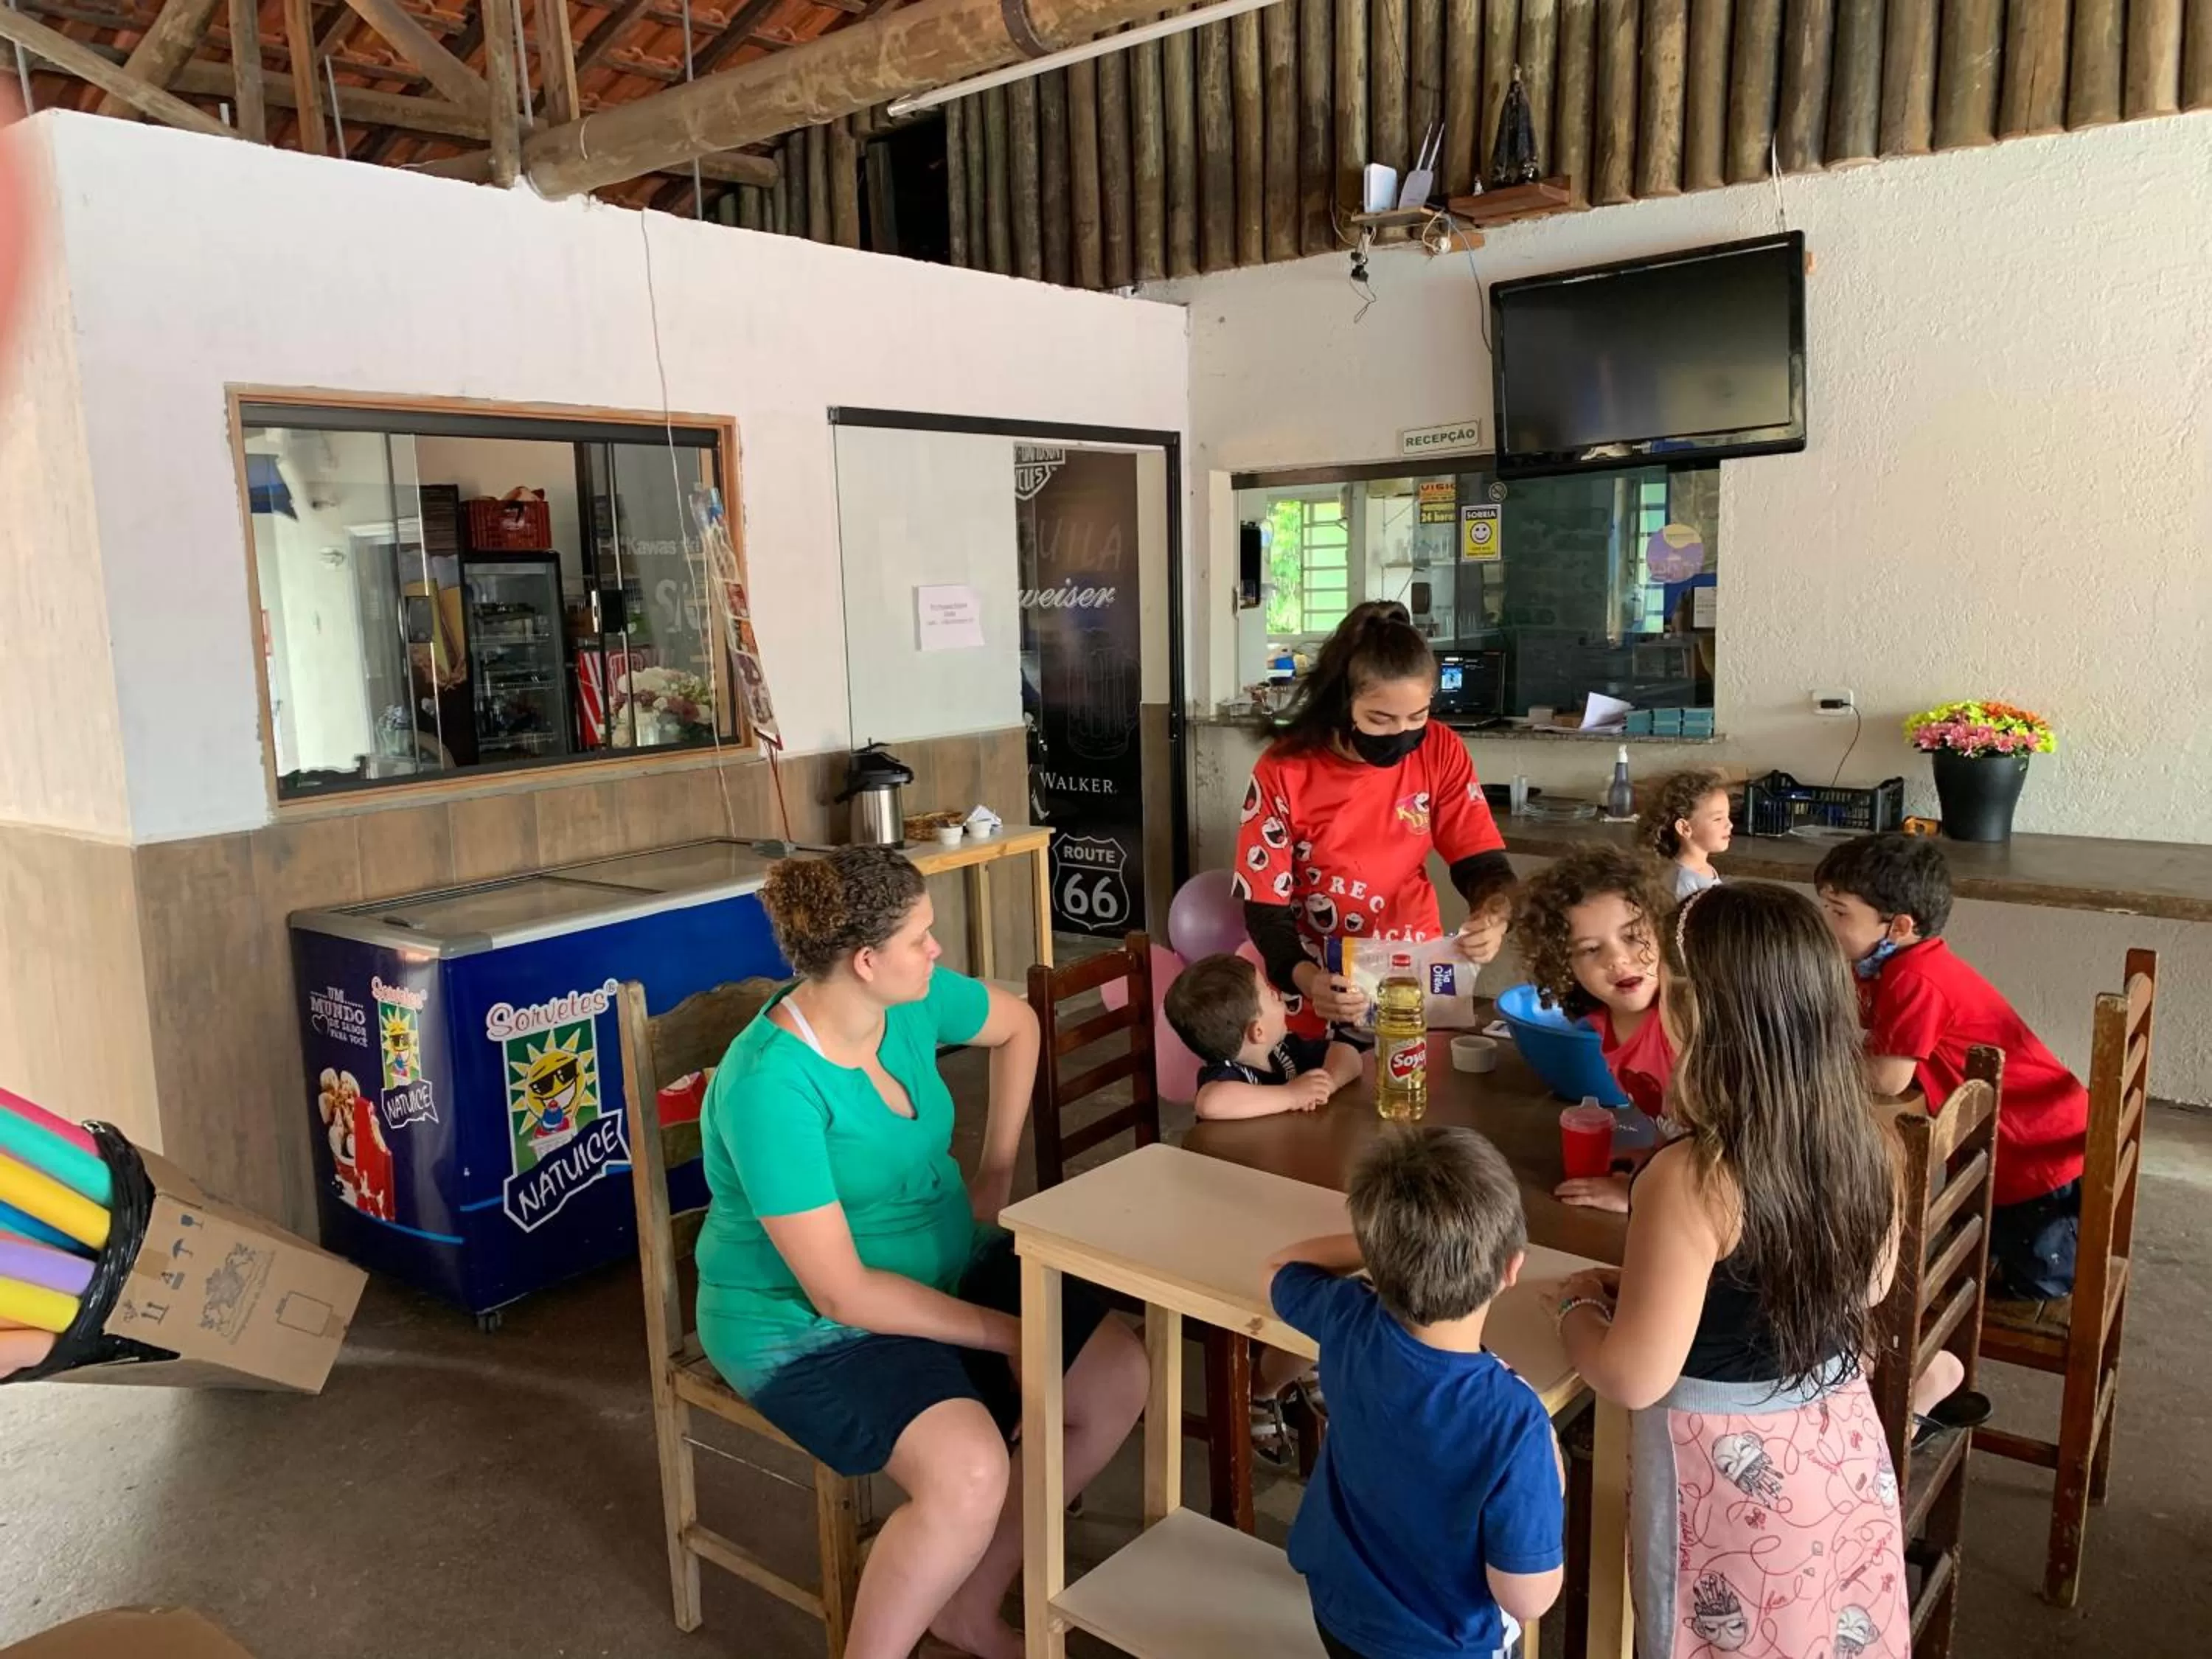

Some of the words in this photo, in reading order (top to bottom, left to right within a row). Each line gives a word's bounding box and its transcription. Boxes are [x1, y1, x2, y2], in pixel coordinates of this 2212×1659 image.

[1405, 428, 1475, 447] RECEPÇÃO
[1466, 509, 1497, 520] SORRIA
[1063, 845, 1116, 864] ROUTE
[1062, 872, 1119, 919] 66
[327, 986, 345, 1004] UM
[309, 996, 366, 1026] MUNDO
[488, 991, 608, 1039] Sorvetes
[386, 1085, 431, 1121] NATUICE
[518, 1120, 619, 1221] NATUICE
